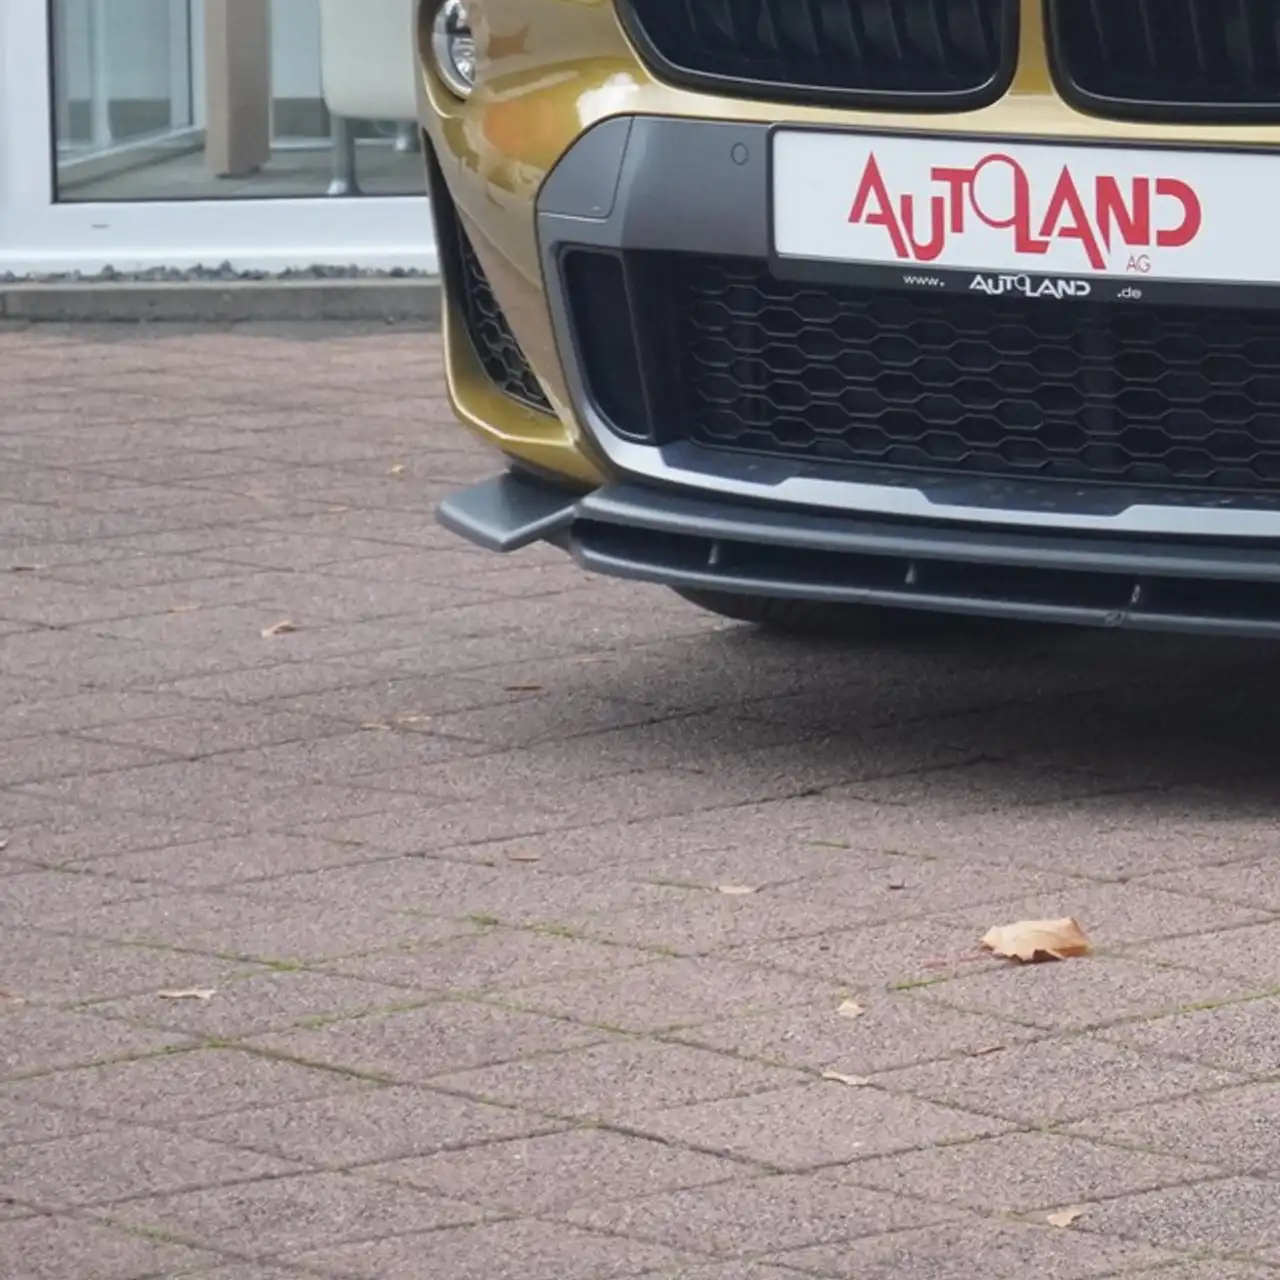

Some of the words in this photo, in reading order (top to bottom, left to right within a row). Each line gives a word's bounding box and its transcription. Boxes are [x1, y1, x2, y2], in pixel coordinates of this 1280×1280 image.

[1126, 255, 1151, 273] AG
[903, 274, 945, 287] www.
[1117, 286, 1142, 299] .de
